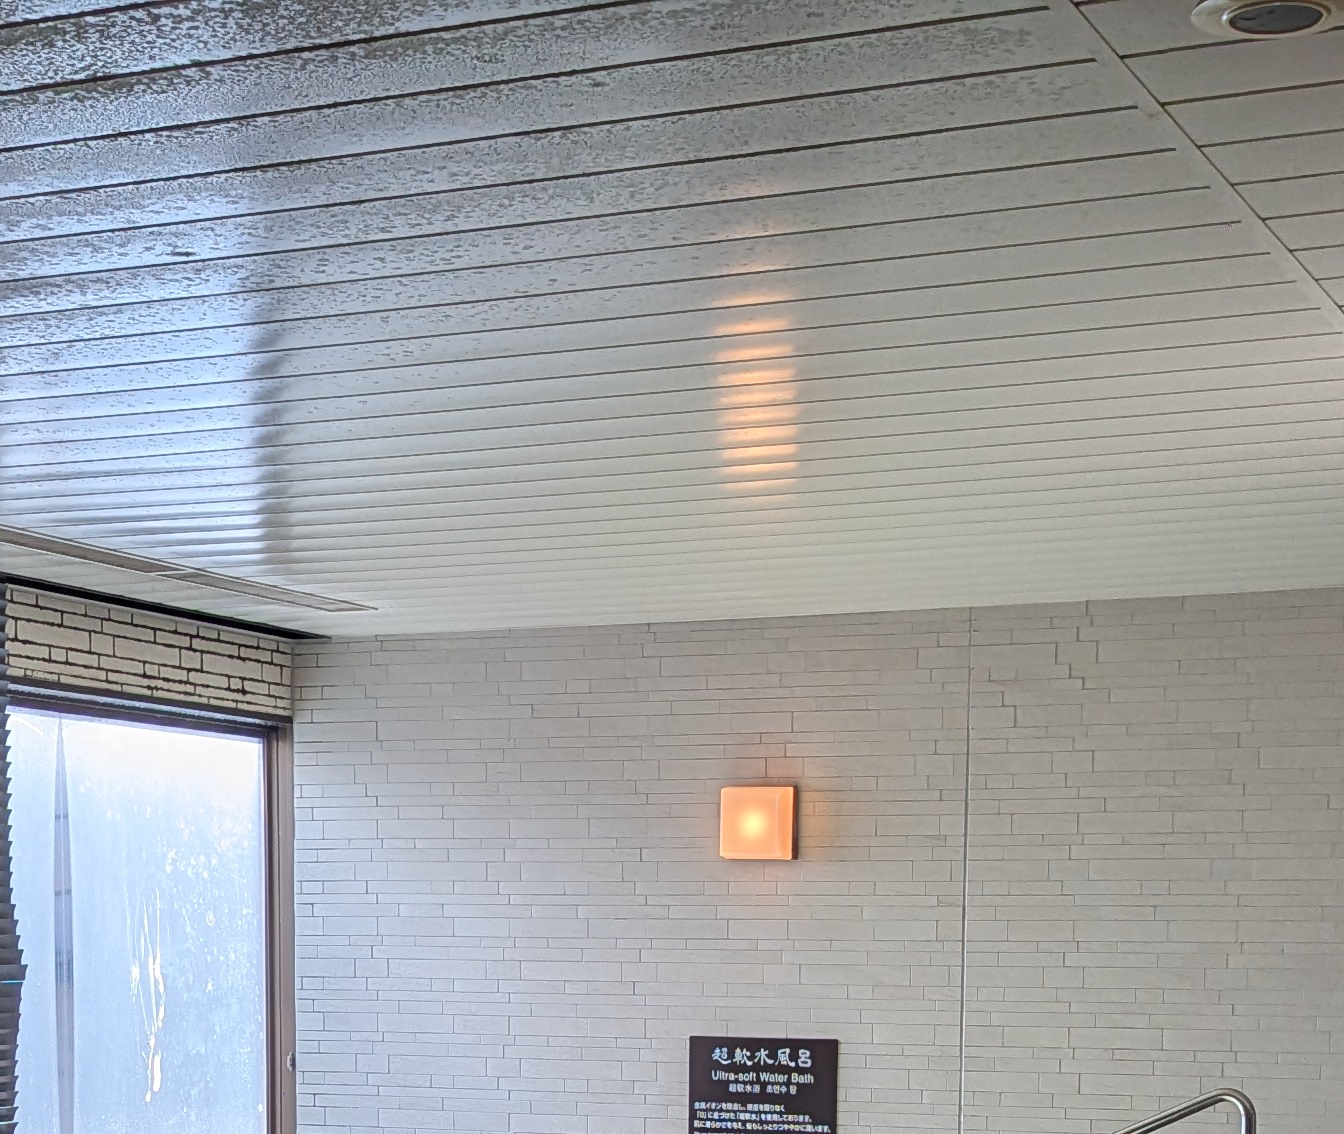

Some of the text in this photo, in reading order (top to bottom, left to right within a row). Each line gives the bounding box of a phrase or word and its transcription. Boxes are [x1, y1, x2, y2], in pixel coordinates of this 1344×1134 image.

[712, 1046, 812, 1068] 超軟水風呂
[711, 1070, 815, 1084] Ultra-soft Water Bath
